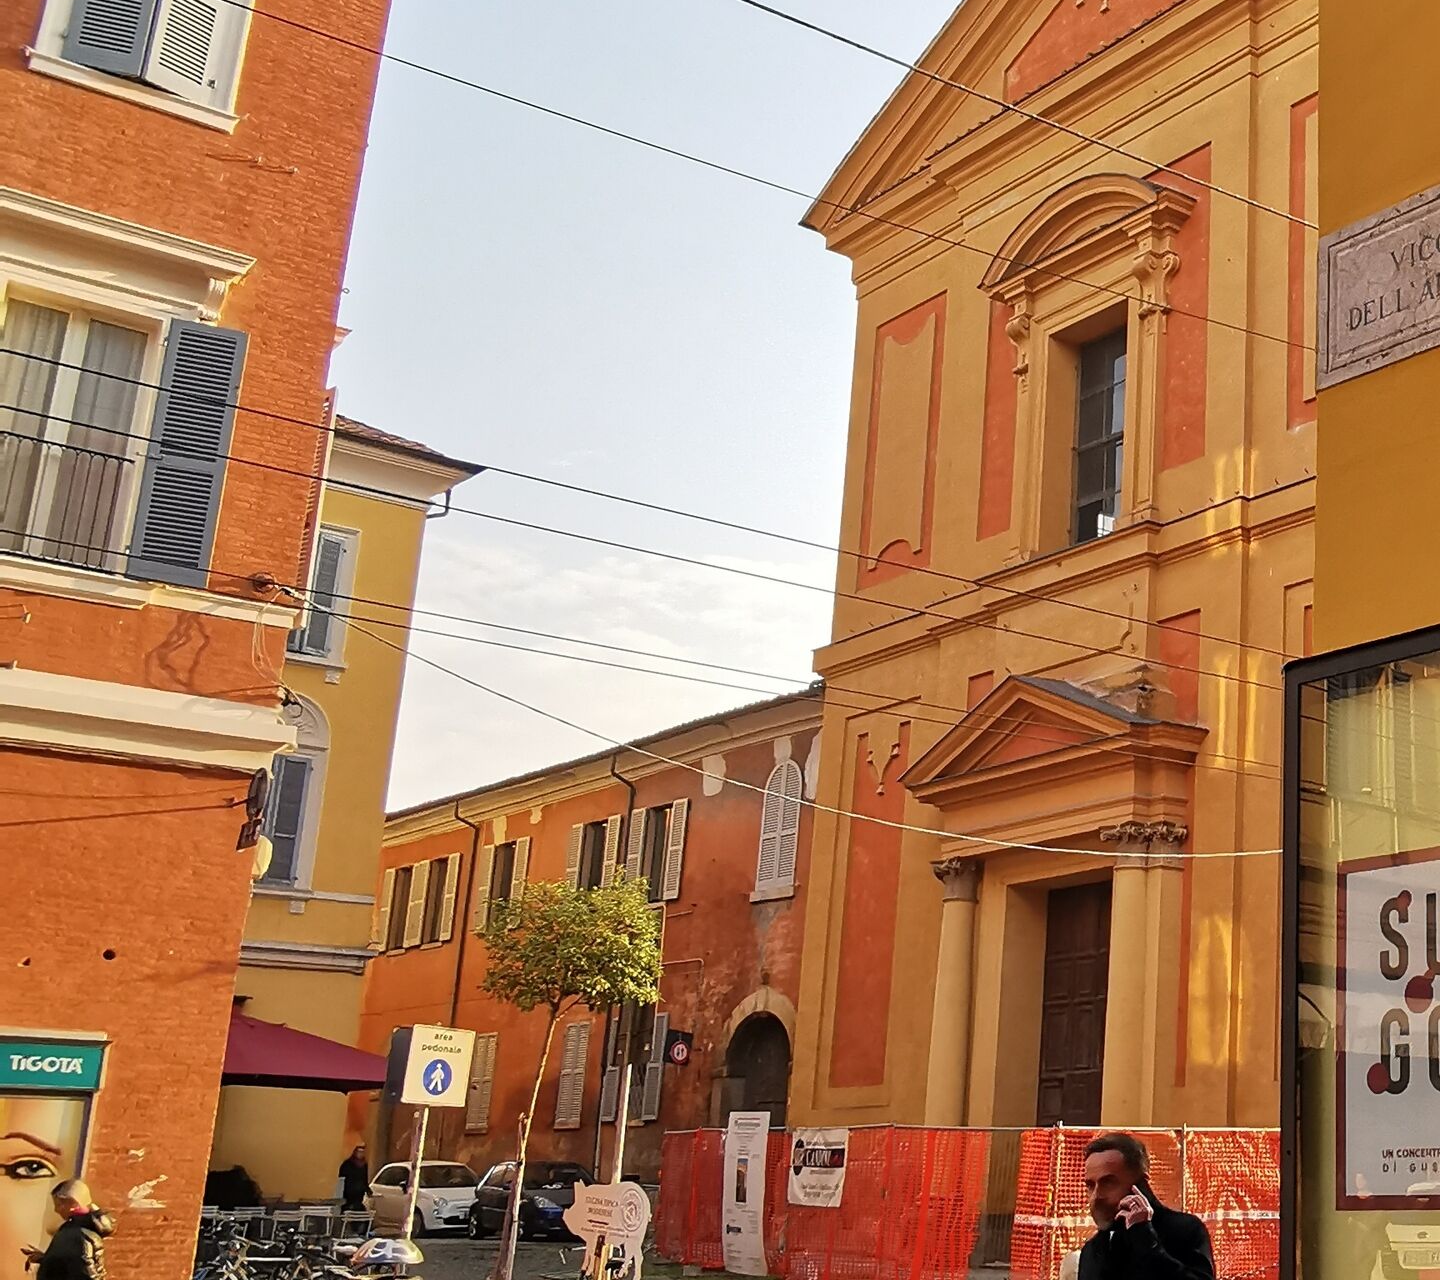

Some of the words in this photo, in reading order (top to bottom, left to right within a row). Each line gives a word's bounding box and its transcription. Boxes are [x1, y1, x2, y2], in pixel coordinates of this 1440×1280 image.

[434, 1033, 453, 1041] area
[421, 1044, 462, 1054] pedonale
[1382, 1149, 1394, 1159] UN
[1382, 1161, 1397, 1173] DI
